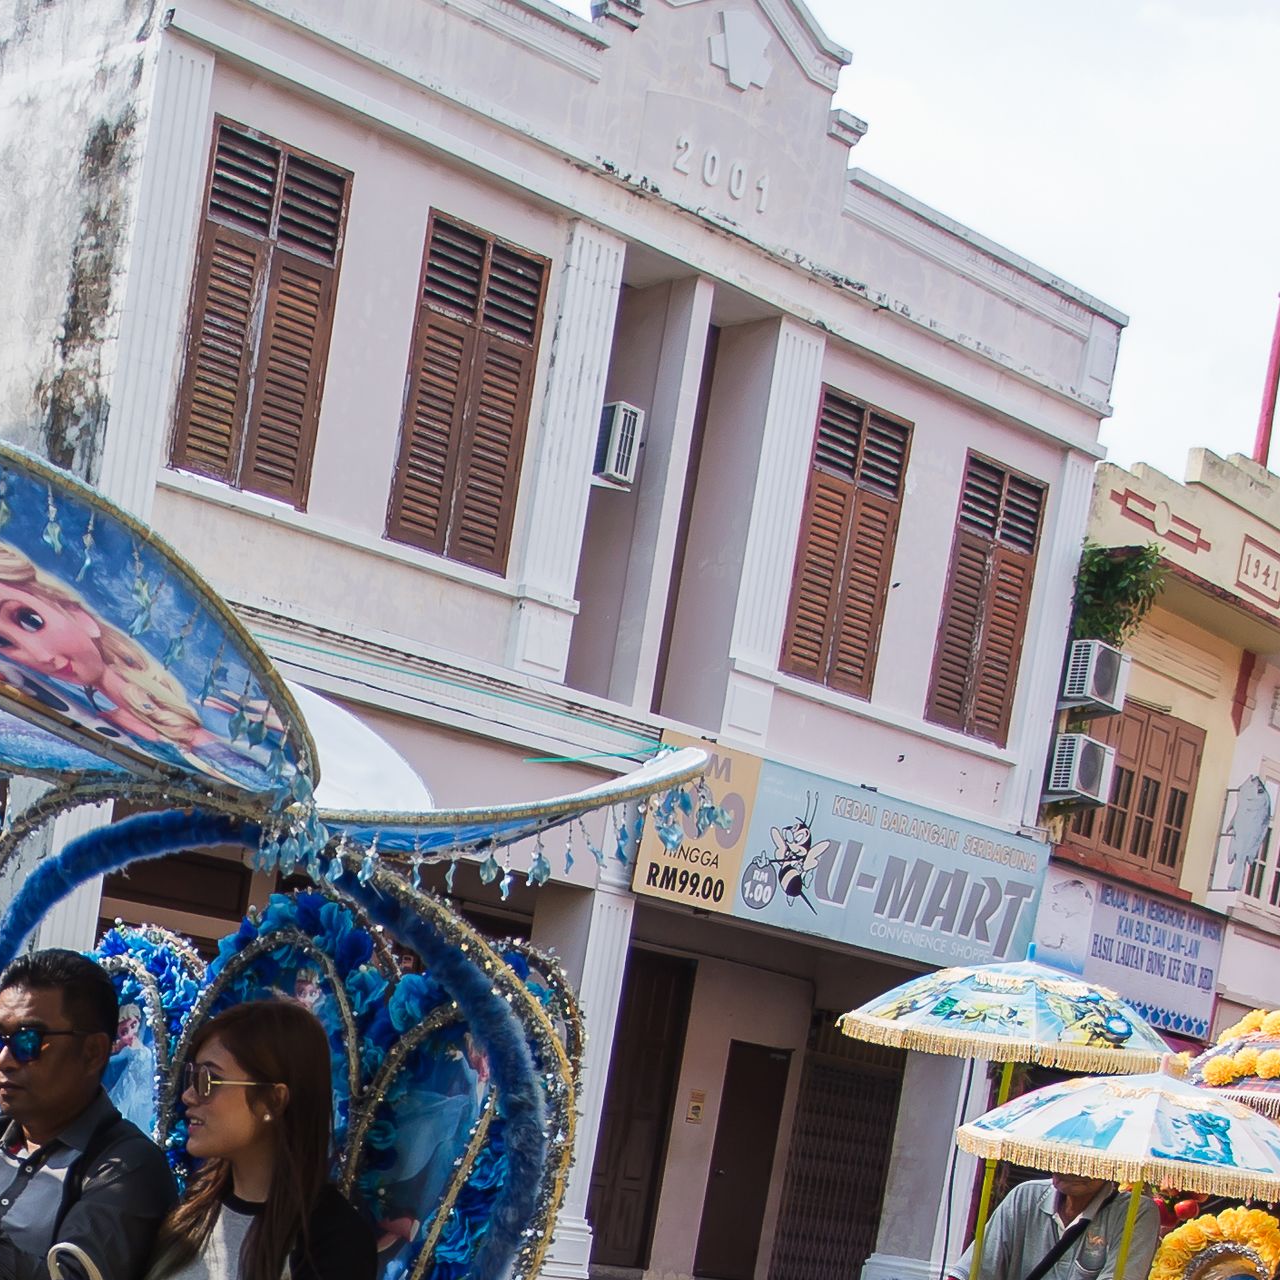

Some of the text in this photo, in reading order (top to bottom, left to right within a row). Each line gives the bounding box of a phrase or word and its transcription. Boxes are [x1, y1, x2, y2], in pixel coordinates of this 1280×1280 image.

[673, 134, 771, 214] 2001
[1243, 553, 1280, 592] 1941
[832, 795, 1037, 873] KEDAI BARANGAN SERBAGUNA
[646, 862, 725, 902] RM99.00
[744, 881, 772, 904] 1.00
[752, 870, 769, 883] RM
[814, 839, 1036, 960] U-MART
[870, 922, 990, 962] CONVENIENCE SHOPPE
[1091, 933, 1115, 962] HASIL
[1115, 941, 1146, 970] LAUTAN
[1146, 950, 1166, 977] HONG
[1167, 957, 1182, 981] KEE
